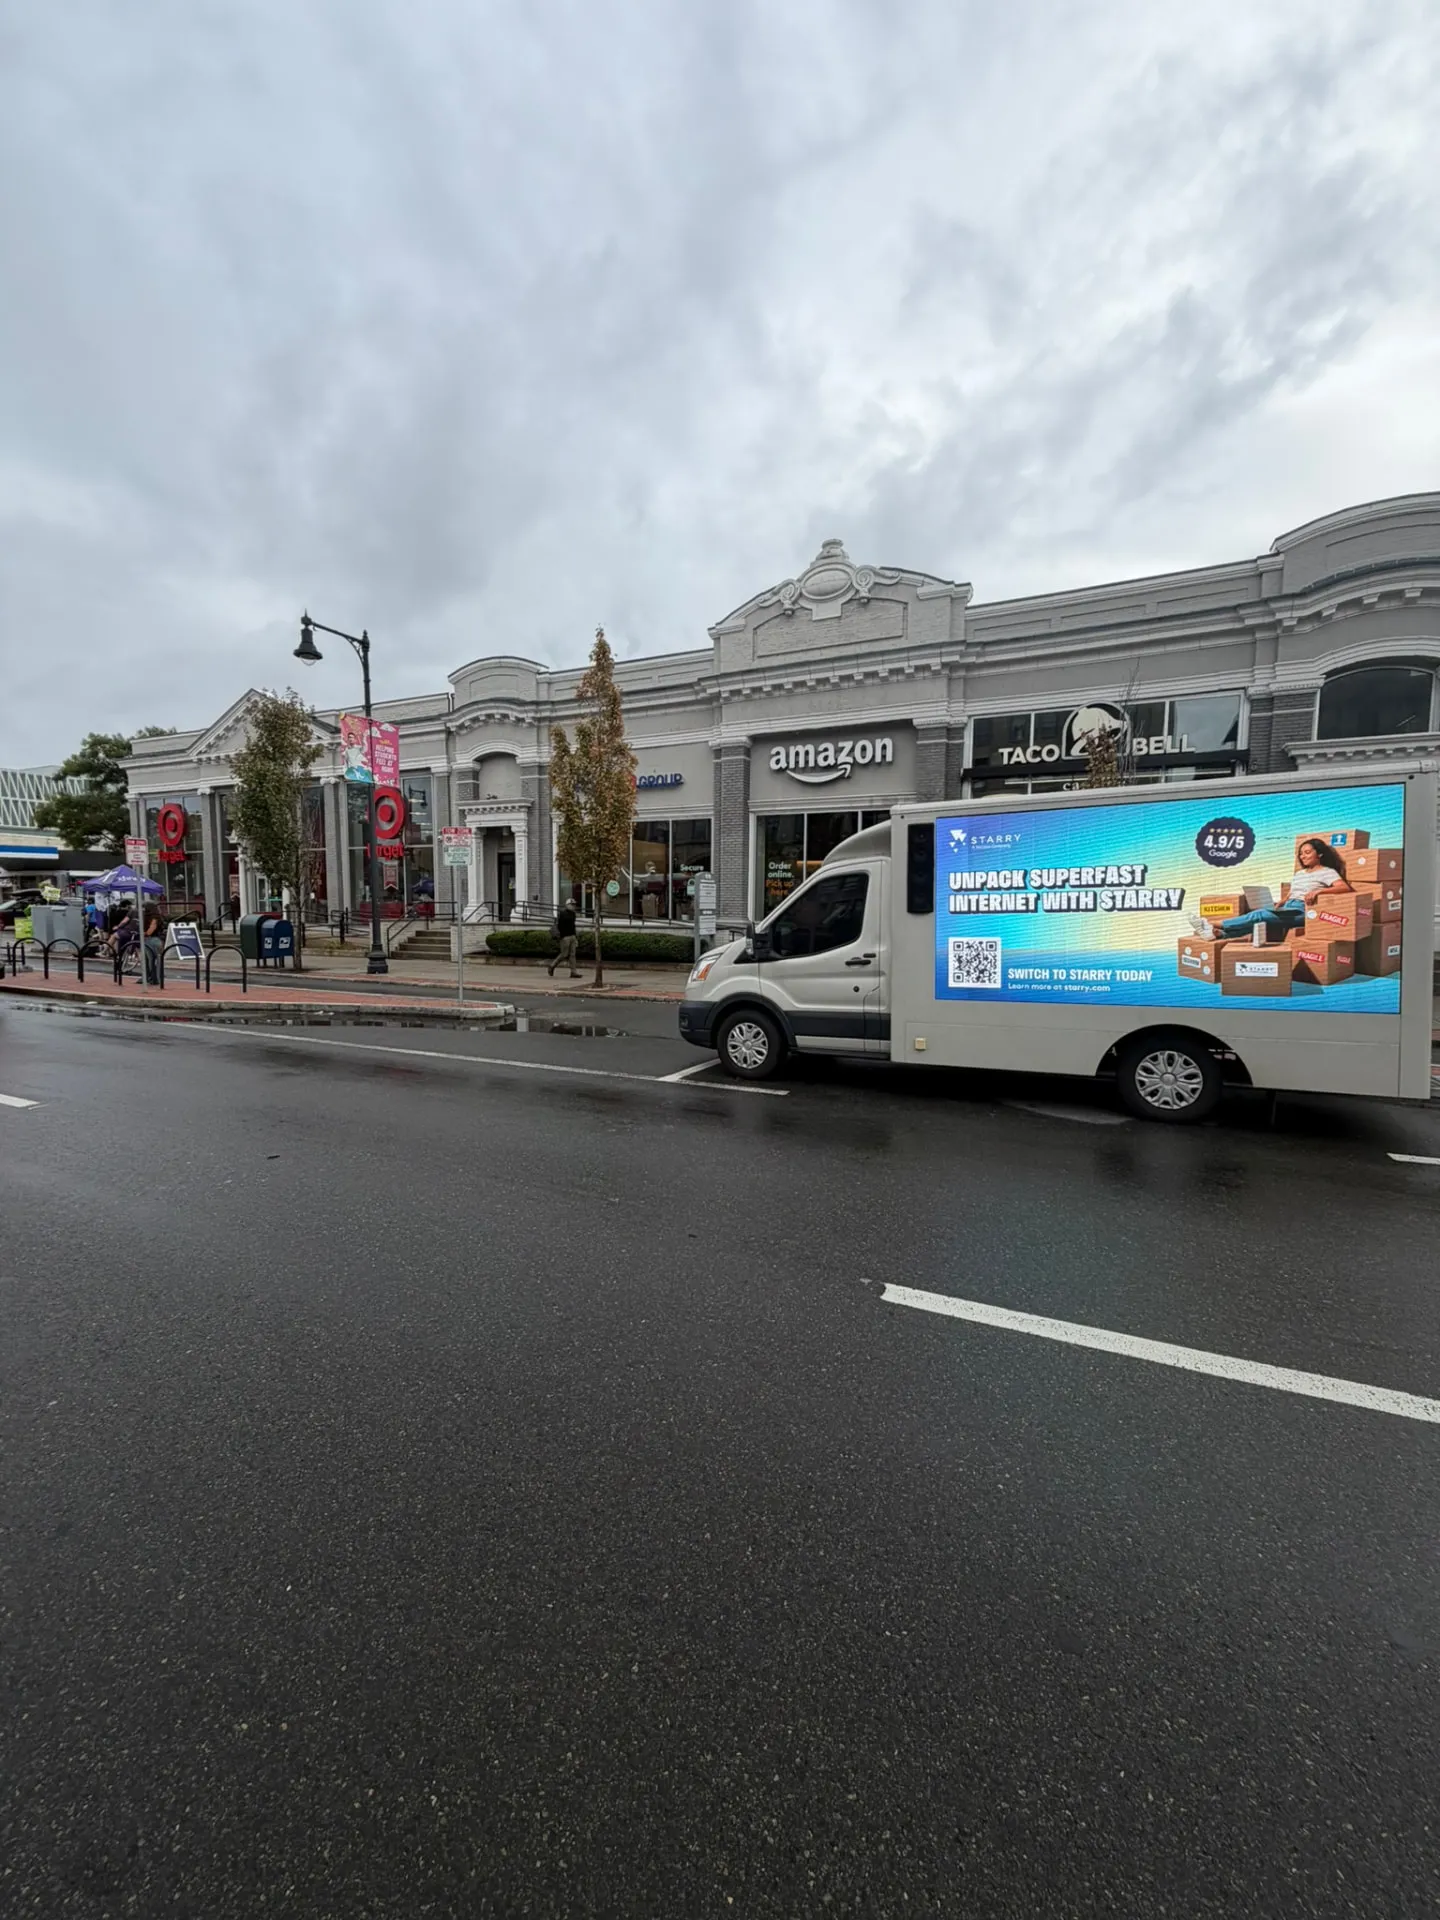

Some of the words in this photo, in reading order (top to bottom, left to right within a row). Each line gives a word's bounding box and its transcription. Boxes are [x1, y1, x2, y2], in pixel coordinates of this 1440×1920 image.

[769, 737, 893, 770] amazon
[998, 743, 1060, 765] TACO
[1132, 733, 1196, 756] BELL
[637, 773, 684, 790] GROUP
[971, 834, 1021, 845] STARRY
[1204, 835, 1245, 849] 4.9/5
[1208, 849, 1238, 859] Google
[680, 863, 704, 872] Secure
[768, 861, 792, 870] Order
[767, 871, 795, 879] online.
[949, 869, 1027, 892] UNPACK
[1029, 864, 1147, 890] SUPERFAST
[949, 892, 1039, 914] INTERNET
[1041, 891, 1097, 913] WITH
[1099, 888, 1186, 912] STARRY
[1320, 912, 1348, 925] FRAGILE
[1298, 951, 1323, 962] FRAGILE
[1008, 968, 1050, 980] SWITCH
[1052, 969, 1067, 980] TO
[1069, 969, 1112, 981] STARRY
[1115, 970, 1153, 982] TODAY
[1064, 984, 1111, 992] starry.com
